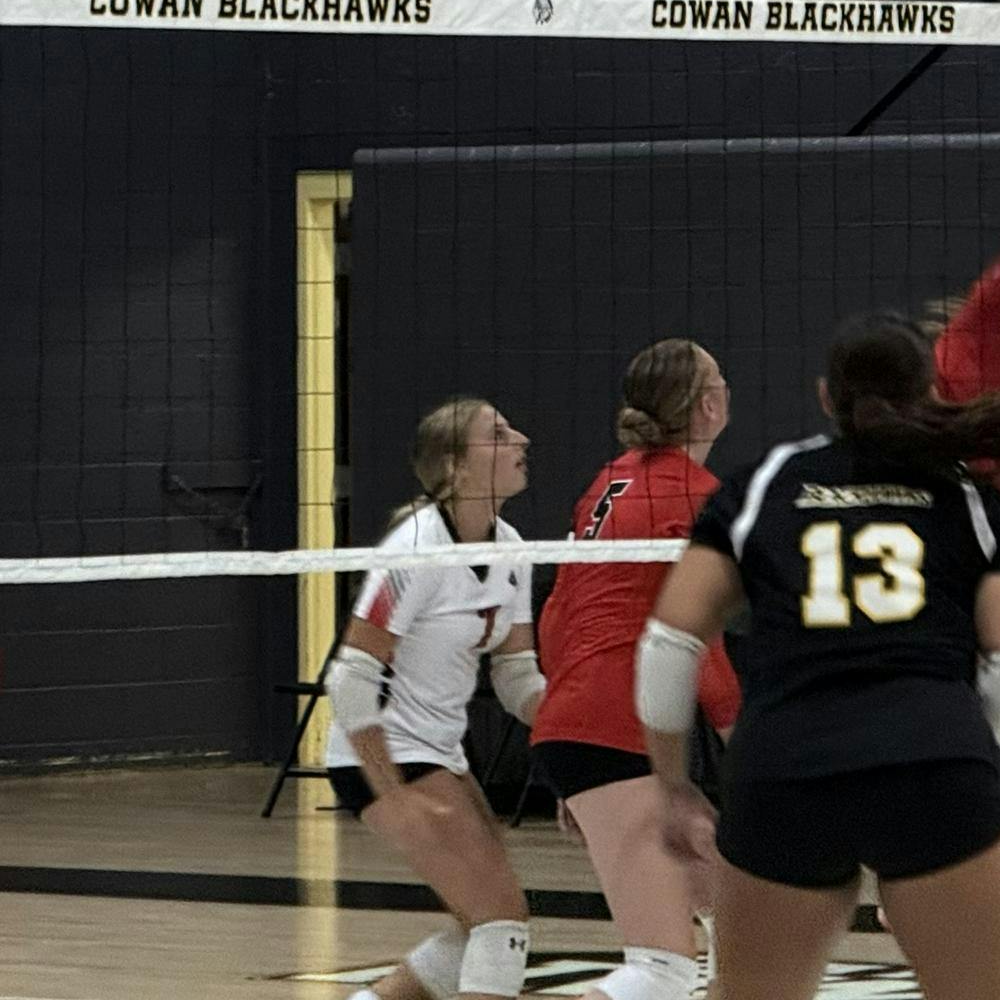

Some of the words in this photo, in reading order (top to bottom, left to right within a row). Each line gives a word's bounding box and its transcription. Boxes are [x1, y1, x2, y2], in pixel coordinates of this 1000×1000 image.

[651, 0, 753, 30] COWAN
[765, 1, 955, 33] BLACKHAWKS
[801, 520, 927, 629] 13
